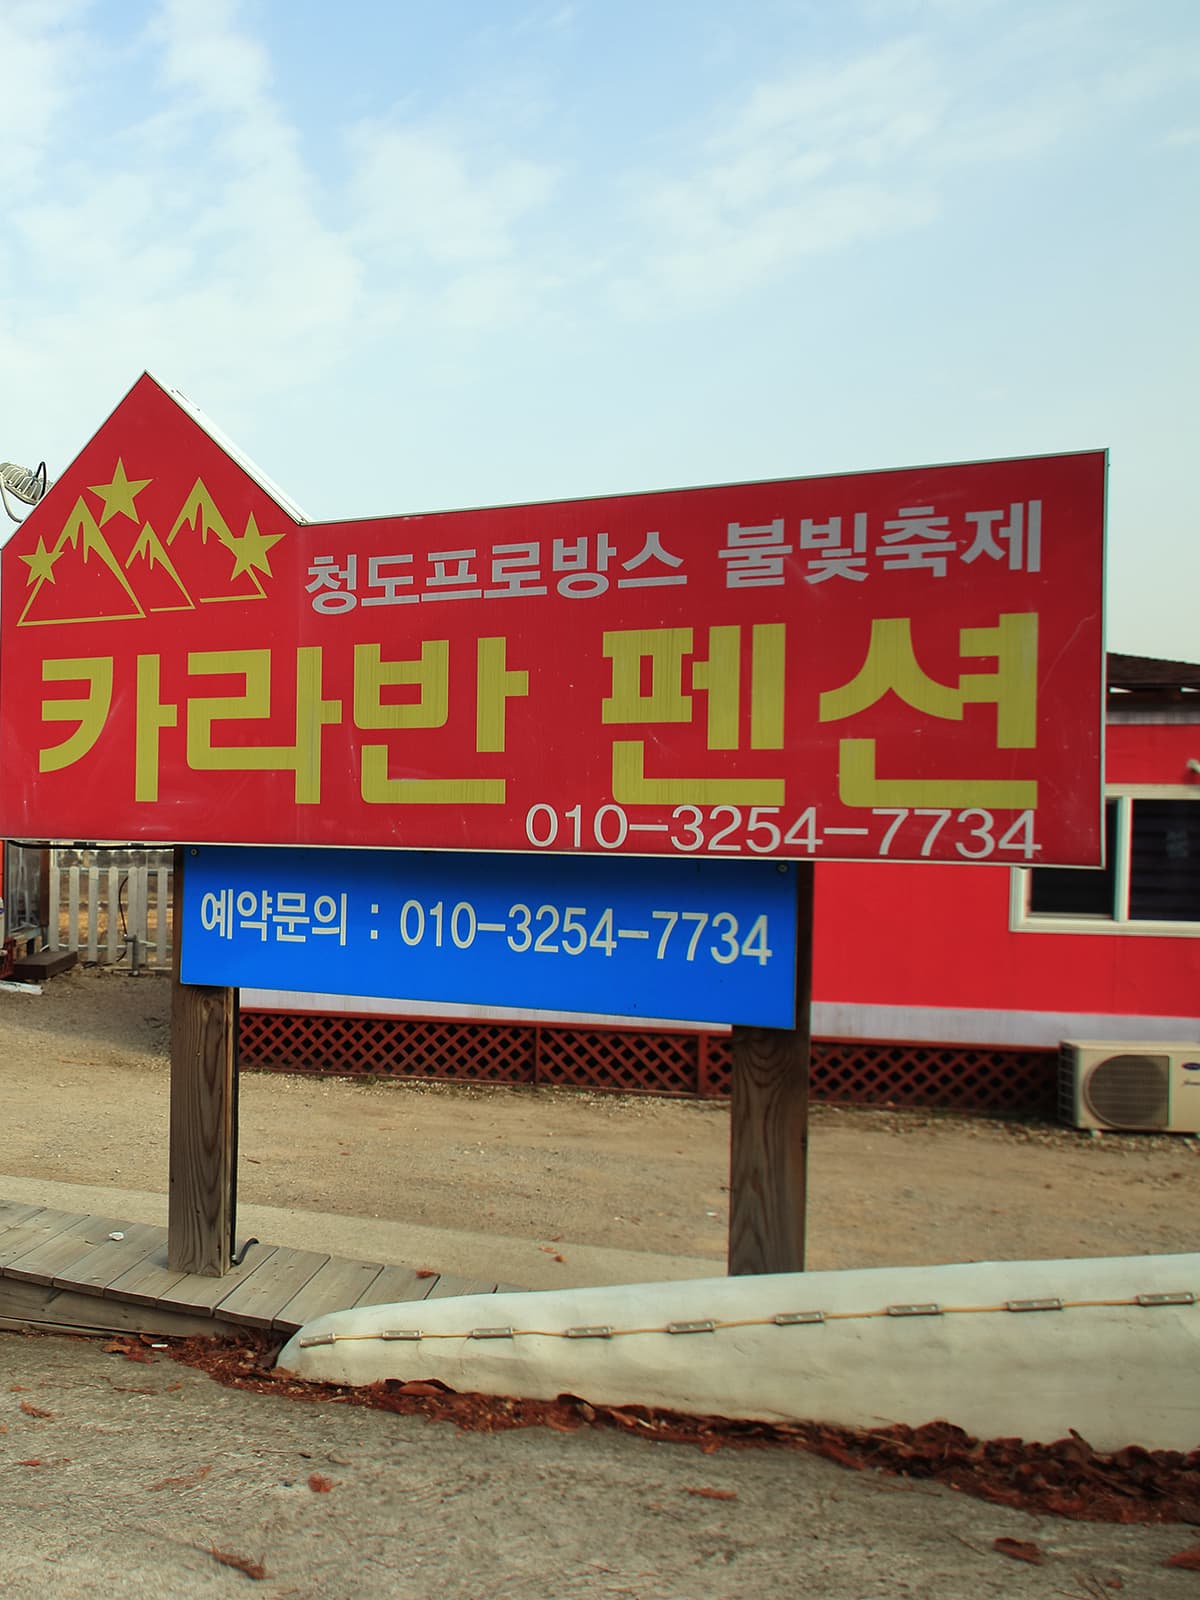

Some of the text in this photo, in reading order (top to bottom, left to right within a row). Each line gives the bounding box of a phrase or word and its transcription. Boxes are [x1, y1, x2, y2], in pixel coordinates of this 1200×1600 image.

[304, 500, 1042, 615] 청도프로방스 불빛축제
[39, 613, 1038, 809] 카라반 펜션
[525, 803, 1042, 860] 010-3254-7734
[200, 888, 348, 947] 예약문의
[400, 899, 773, 966] 010-3254-7734
